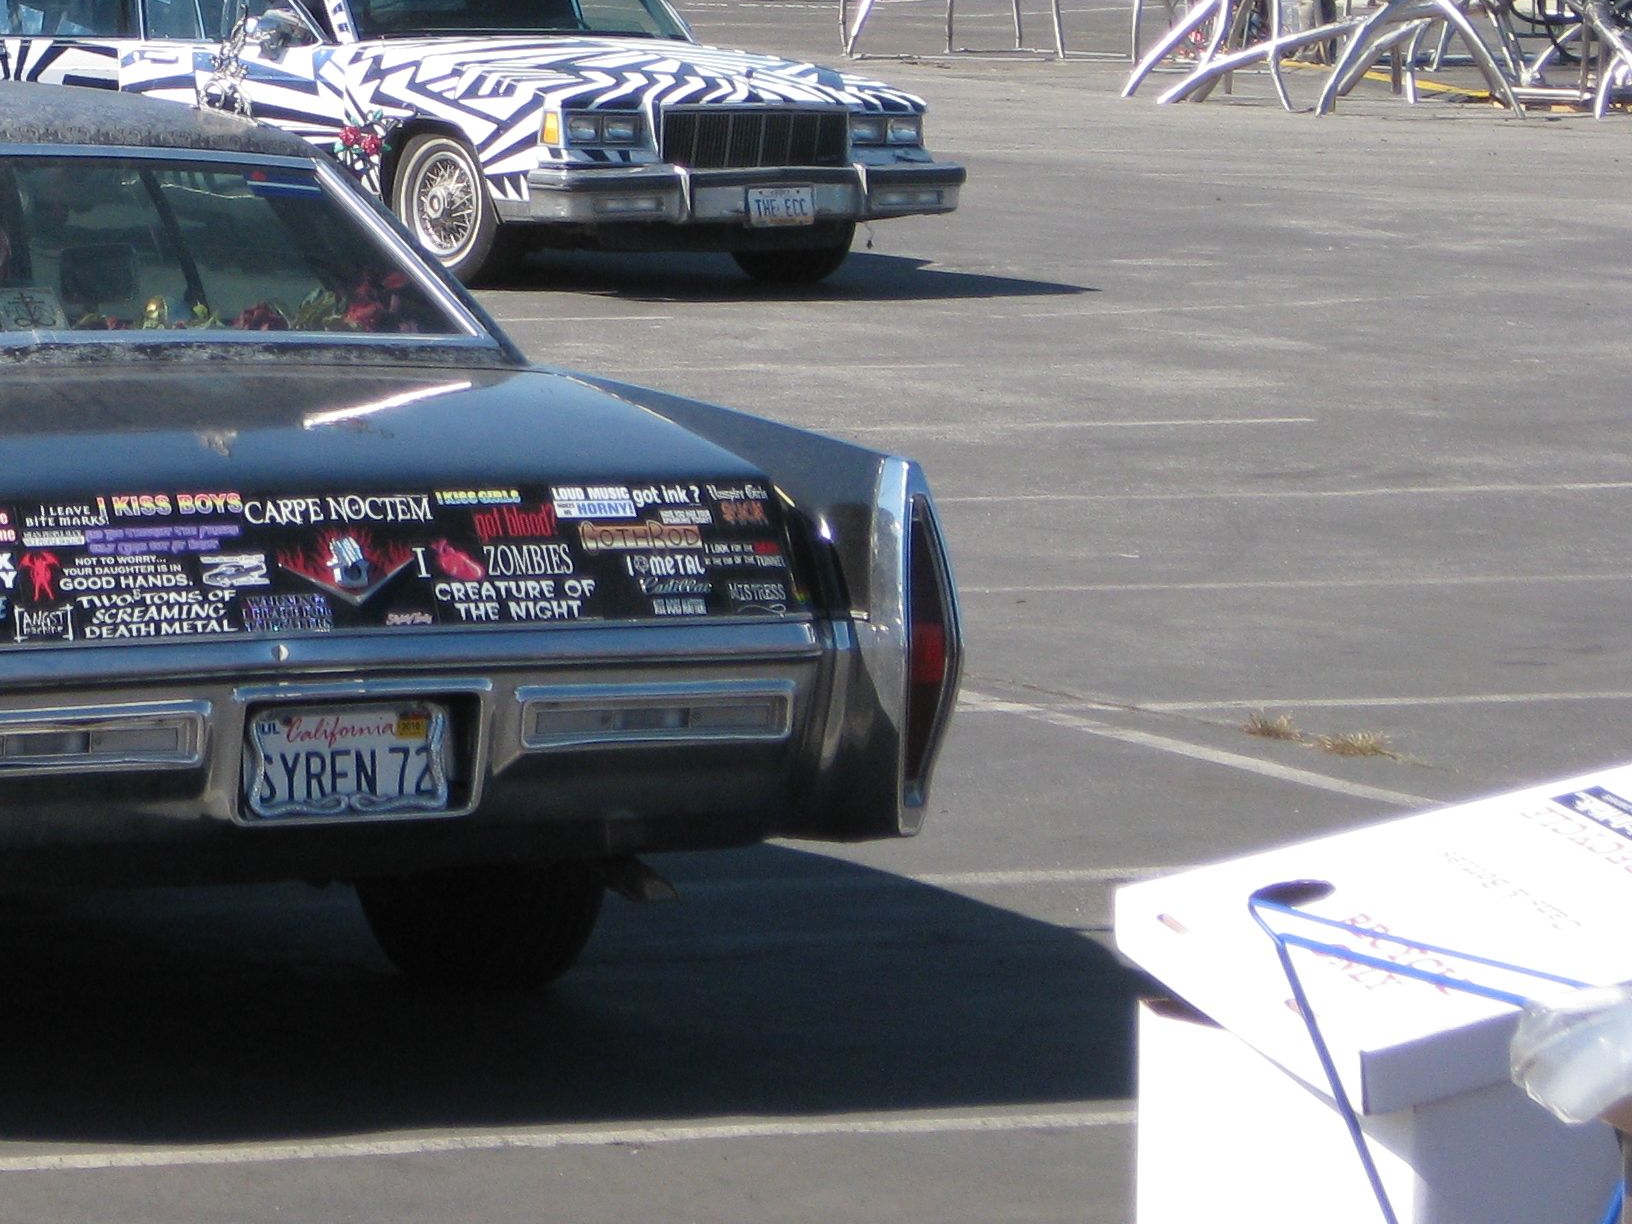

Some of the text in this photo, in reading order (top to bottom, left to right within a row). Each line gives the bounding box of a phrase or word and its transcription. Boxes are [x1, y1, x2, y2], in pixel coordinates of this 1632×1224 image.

[754, 198, 779, 217] THE
[478, 488, 522, 503] GIRLS
[552, 485, 631, 501] LOUD MUSIC
[632, 484, 662, 509] got
[661, 483, 691, 504] ink
[49, 505, 91, 516] LEAVE
[96, 492, 245, 518] I KISS BOYS
[244, 494, 434, 526] CARPE NOCTEM
[576, 501, 635, 516] HORNY!
[25, 515, 55, 527] BITE
[475, 507, 503, 545] got
[62, 563, 182, 577] YOUR DAUGHTER IS IN
[75, 556, 98, 567] NOT
[100, 556, 115, 566] TO
[412, 543, 575, 578] I ZOMBIES
[626, 554, 635, 577] I
[59, 573, 194, 591] GOOD HANDS.
[435, 578, 597, 602] CREATURE OF
[638, 576, 714, 596] Cadillac
[727, 581, 787, 602] MISTRESS
[142, 590, 203, 605] TONS
[208, 589, 237, 602] OF
[92, 603, 227, 624] SCREAMING
[454, 602, 500, 621] THE
[508, 599, 582, 621] NIGHT
[84, 619, 239, 639] DEATH METAL
[286, 715, 399, 749] California
[260, 747, 378, 806] SYREN
[1338, 913, 1474, 996] RECYCL
